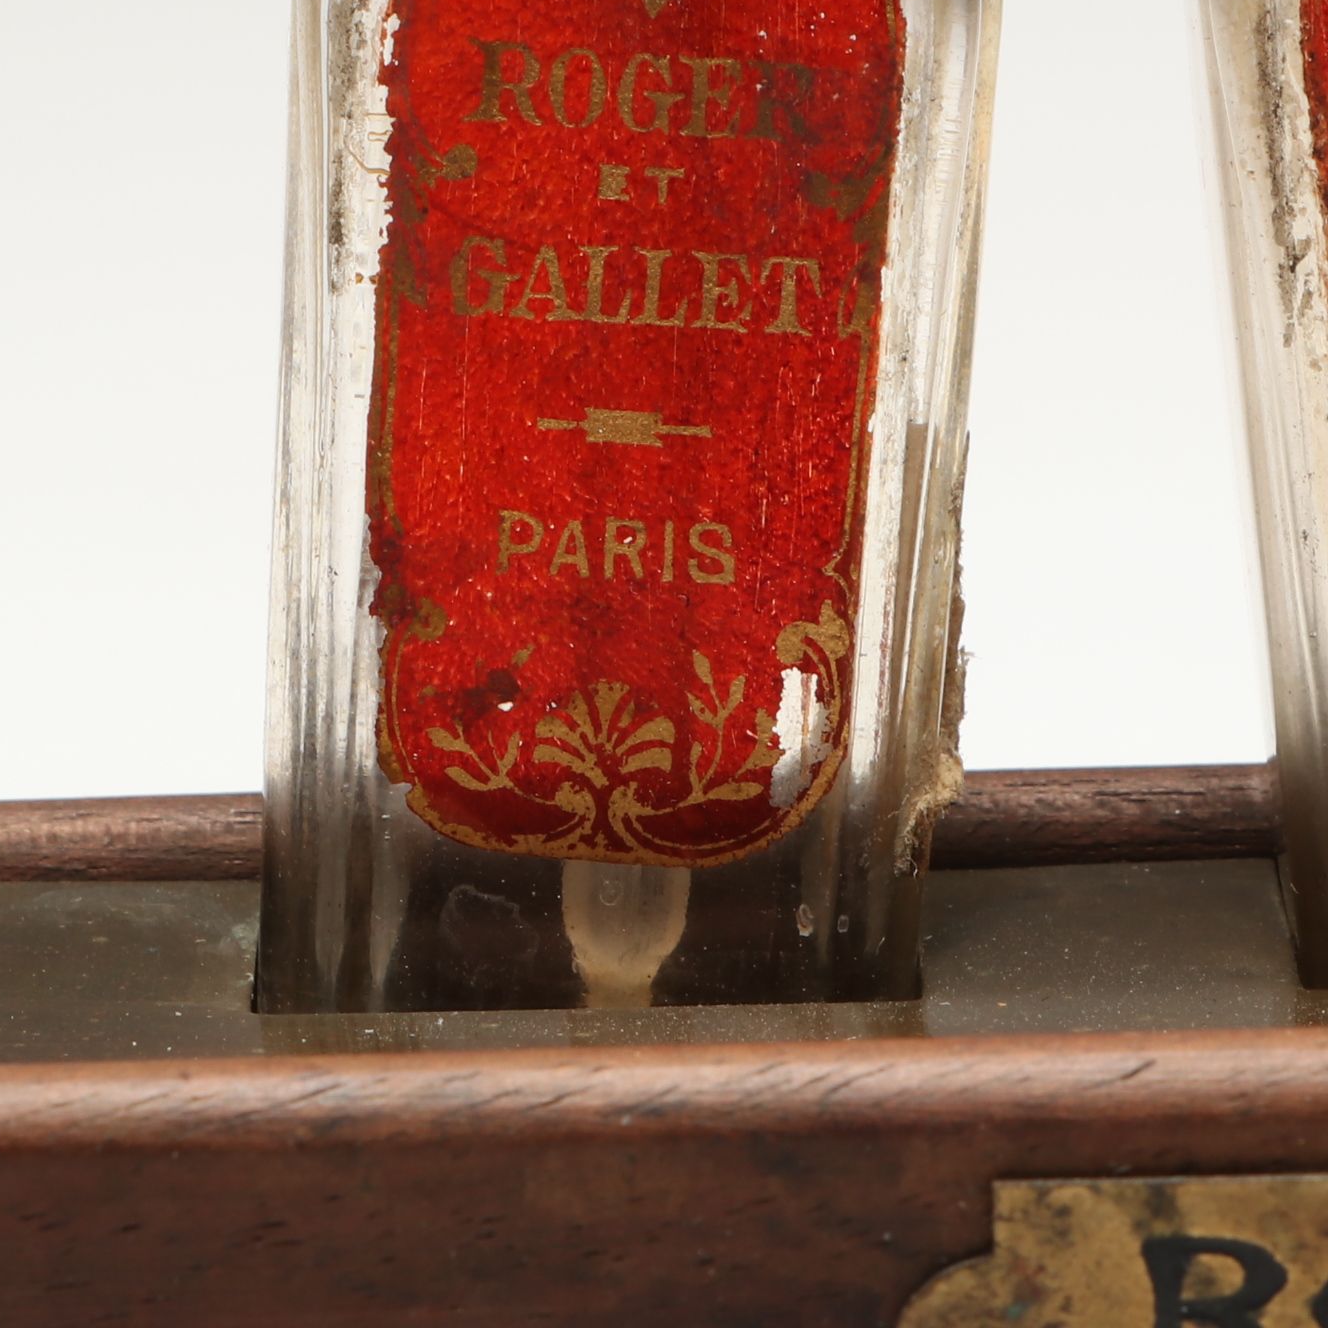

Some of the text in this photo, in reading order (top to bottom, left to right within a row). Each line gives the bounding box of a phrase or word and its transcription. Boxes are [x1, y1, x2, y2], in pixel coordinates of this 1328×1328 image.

[463, 36, 824, 144] ROGER
[598, 164, 685, 204] ET
[449, 235, 824, 338] GALLET
[496, 509, 736, 586] PARIS
